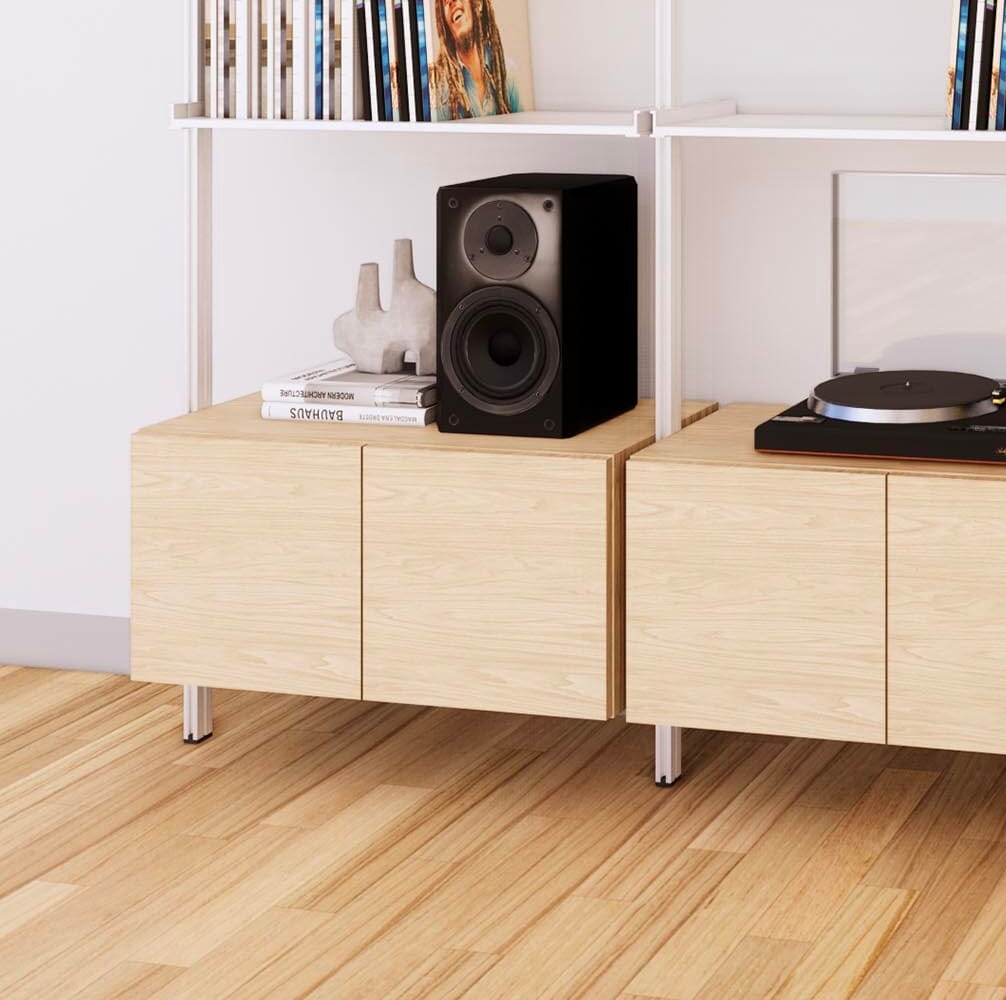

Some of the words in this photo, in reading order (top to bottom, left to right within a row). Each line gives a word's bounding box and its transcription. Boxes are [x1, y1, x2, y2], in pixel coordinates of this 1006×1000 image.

[280, 389, 326, 399] ARCHITECTURE
[327, 392, 354, 400] MODERN
[290, 408, 344, 420] BAUHAUS
